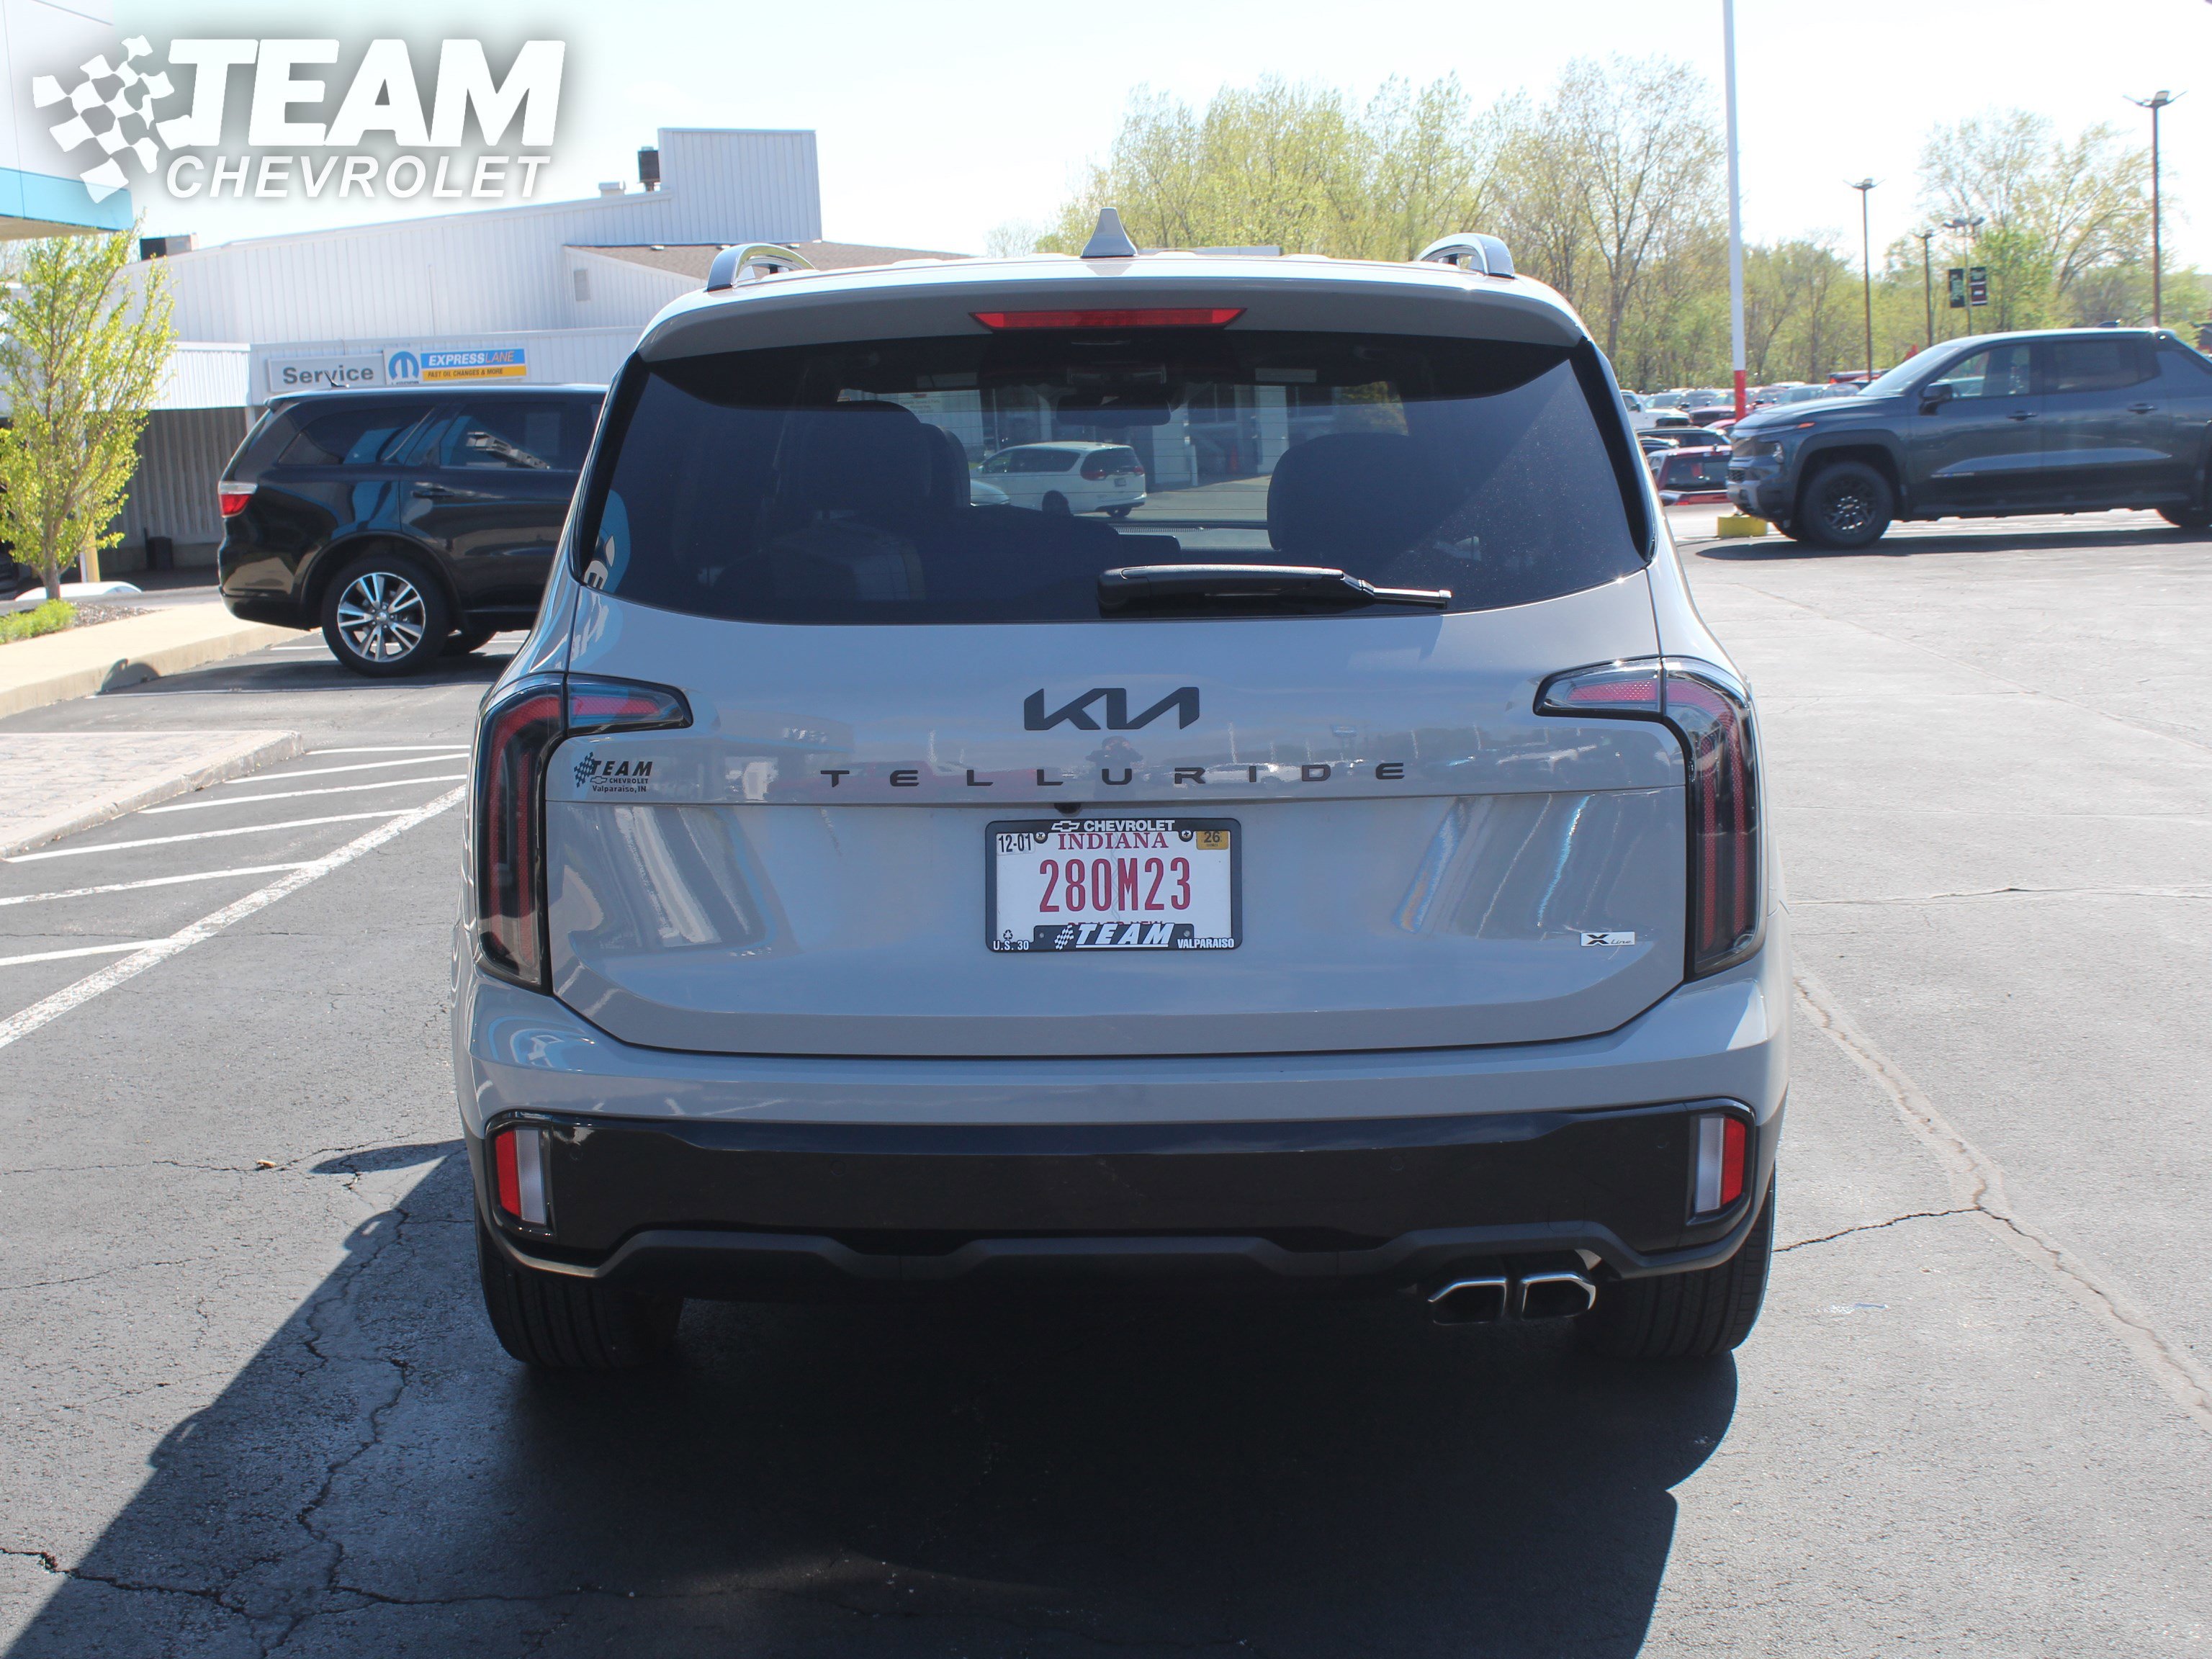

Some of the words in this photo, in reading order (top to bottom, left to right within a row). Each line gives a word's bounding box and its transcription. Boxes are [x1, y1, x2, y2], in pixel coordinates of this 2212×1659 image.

[283, 365, 374, 385] Service
[1024, 686, 1200, 731] KIA
[590, 760, 653, 777] TEAM
[820, 762, 1406, 787] TELLURIDE
[1084, 819, 1175, 832] CHEVROLET
[998, 834, 1032, 853] 12-01
[1058, 832, 1169, 850] INDIANA
[1204, 830, 1220, 843] 26
[1039, 857, 1191, 913] 280M23
[1076, 923, 1174, 945] TEAM
[1586, 934, 1610, 945] X
[993, 940, 1014, 950] U.S.
[1017, 940, 1029, 950] 30
[1177, 938, 1235, 949] VALPARAISO
